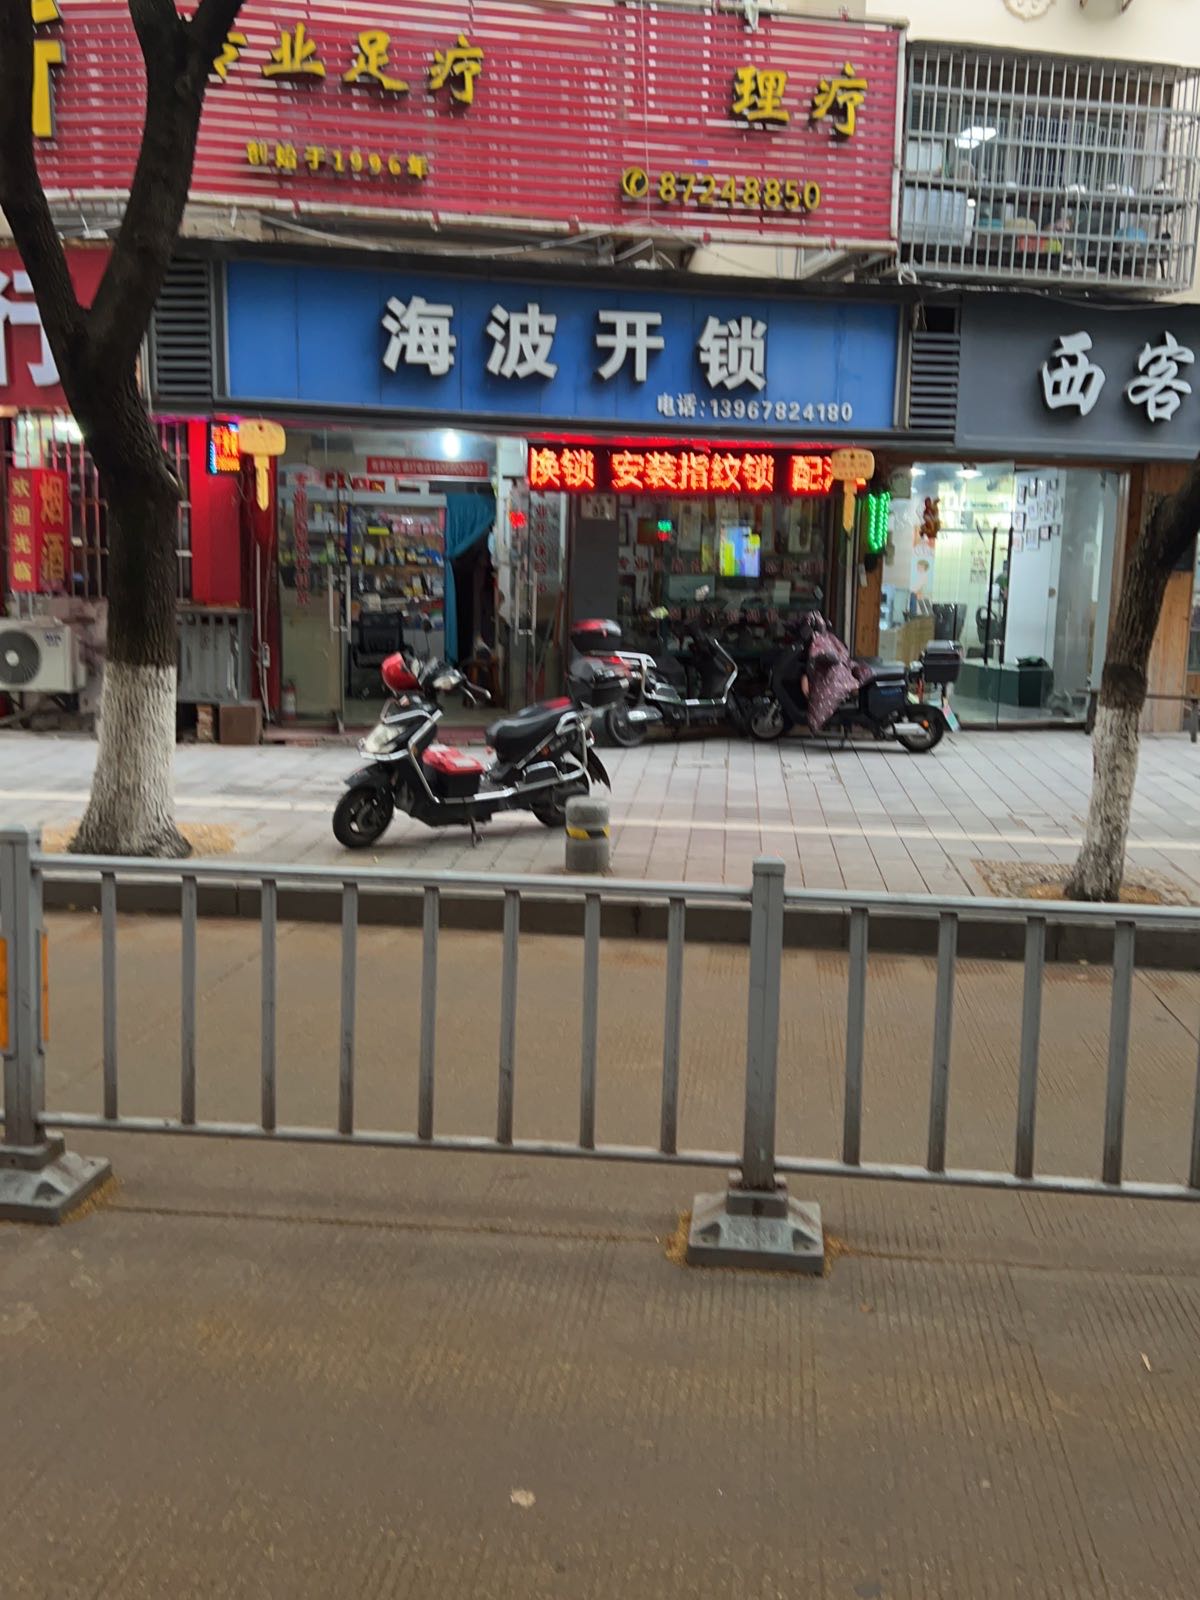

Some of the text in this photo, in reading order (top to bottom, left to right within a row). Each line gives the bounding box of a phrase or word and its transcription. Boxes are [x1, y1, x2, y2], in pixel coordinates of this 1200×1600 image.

[732, 61, 868, 136] 理疗
[660, 171, 821, 210] 87248850
[381, 296, 767, 390] 海波开锁
[611, 450, 774, 491] 安装指纹锁
